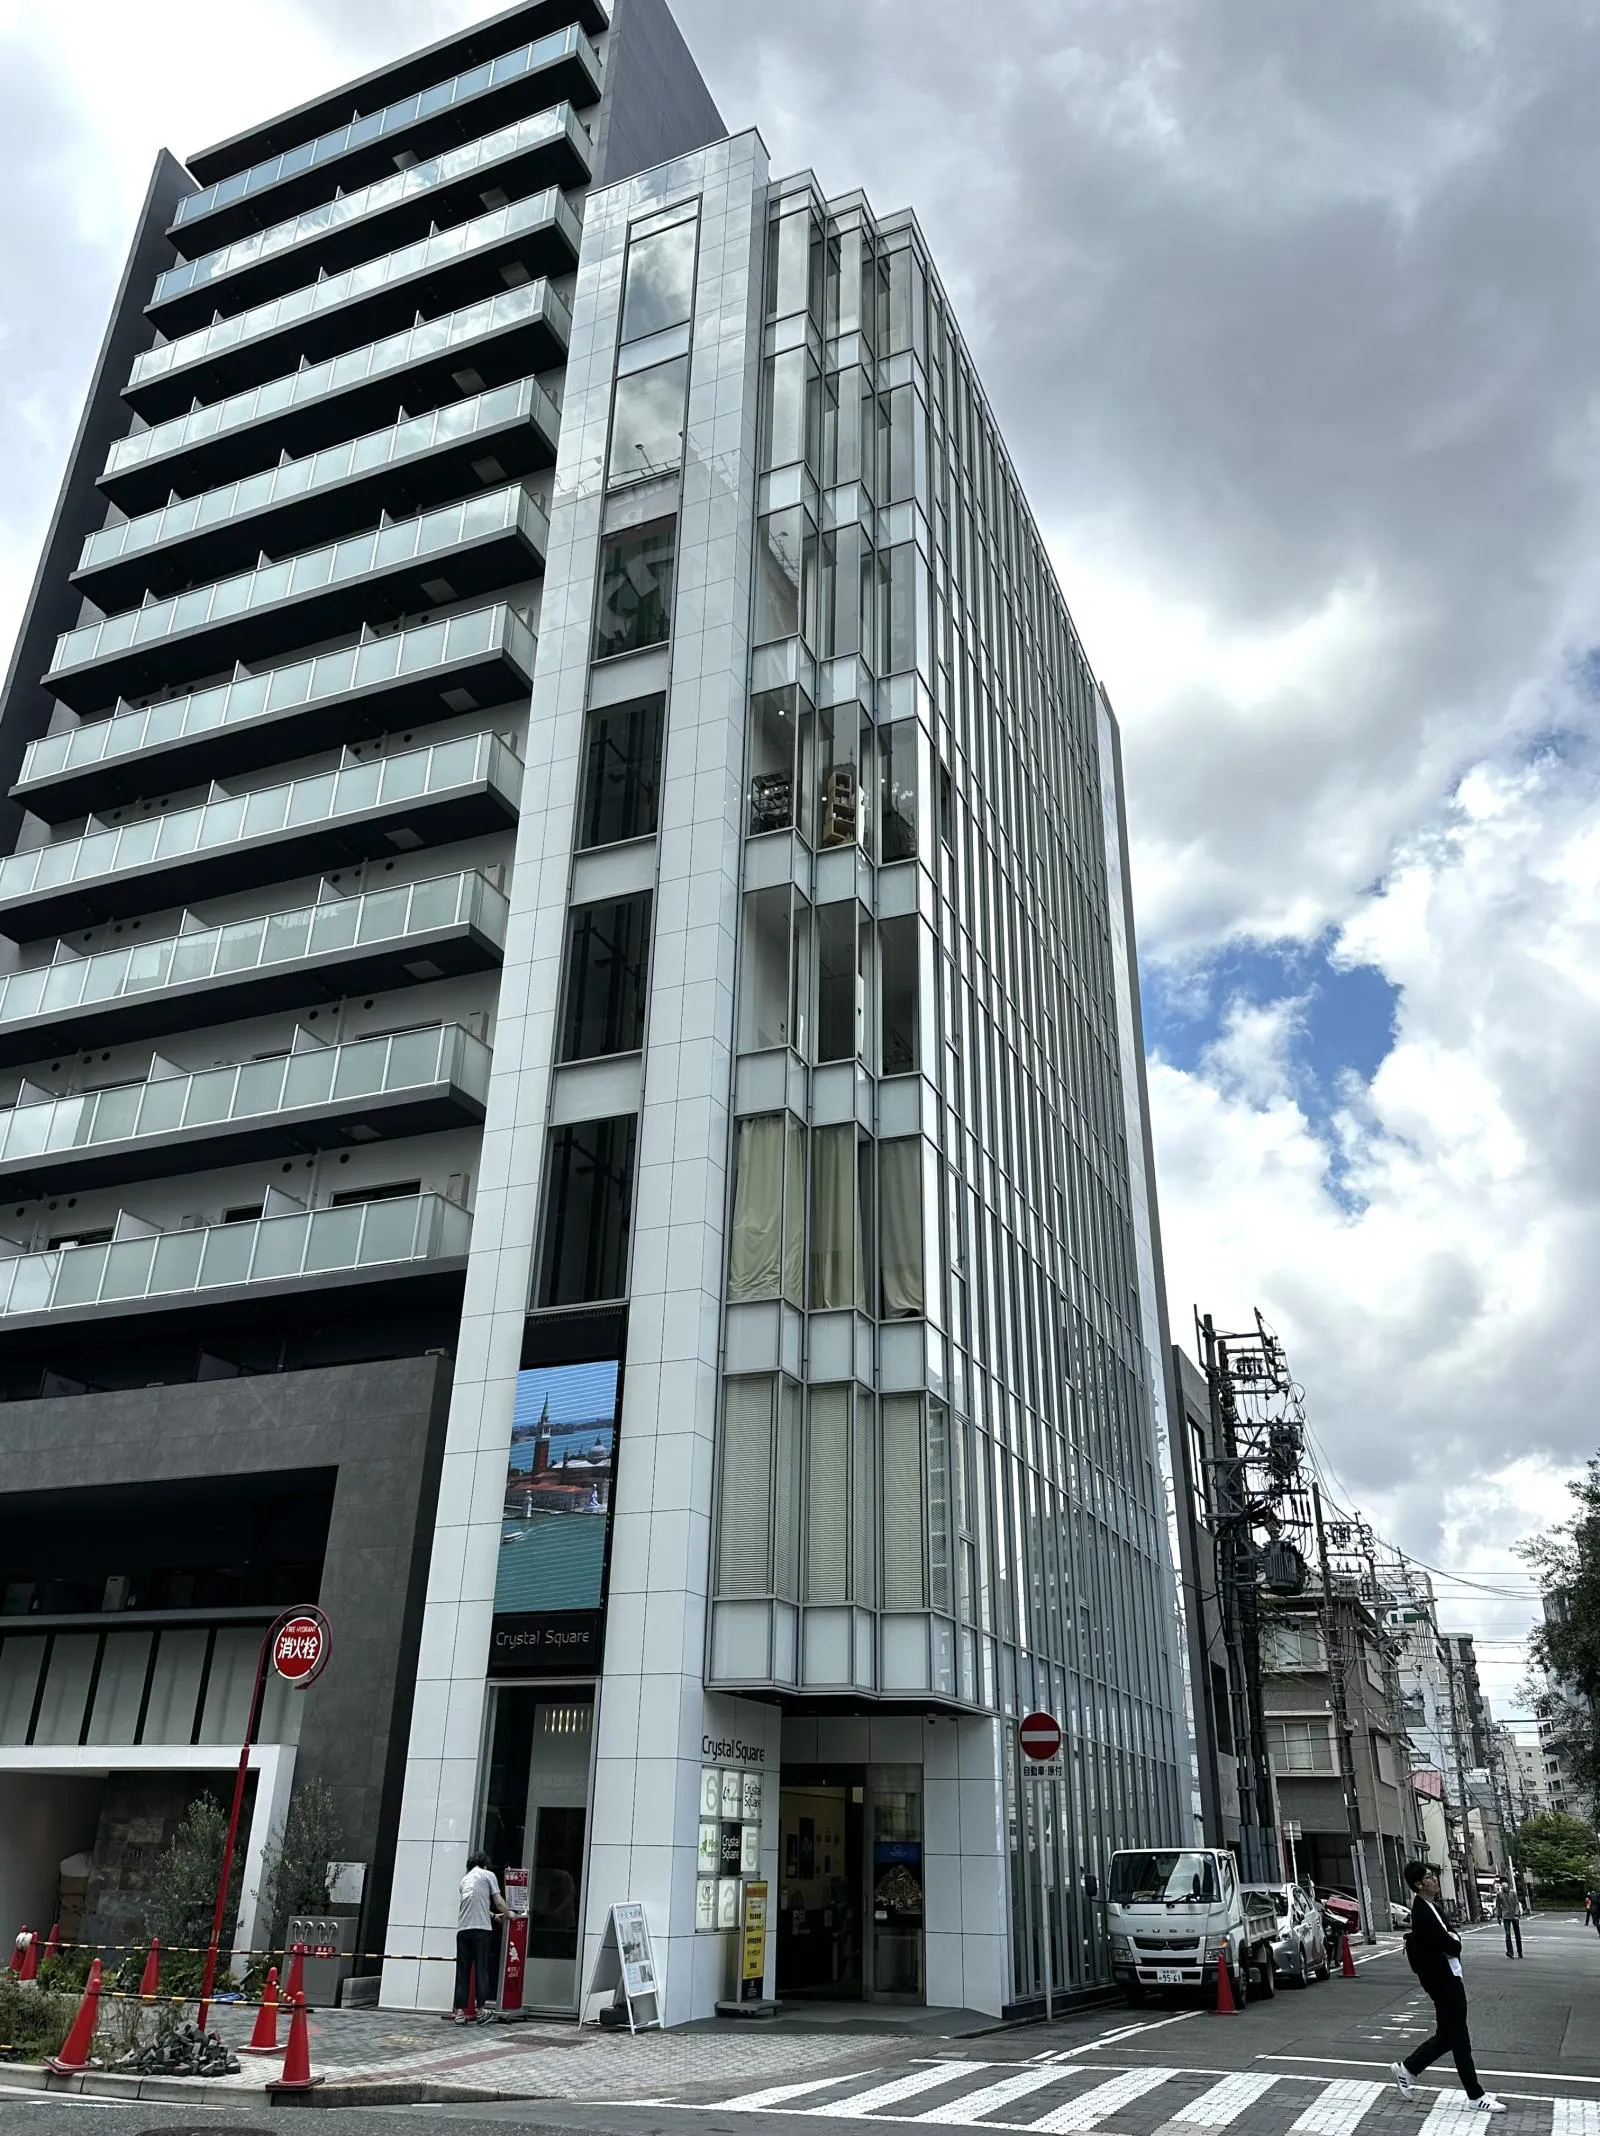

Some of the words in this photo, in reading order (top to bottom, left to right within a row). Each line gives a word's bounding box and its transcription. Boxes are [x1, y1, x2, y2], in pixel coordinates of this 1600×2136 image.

[278, 1636, 318, 1659] 消火栓
[496, 1630, 540, 1649] Crystal
[544, 1629, 590, 1648] Square
[702, 1735, 734, 1761] Crystal
[735, 1740, 765, 1764] Square
[706, 1775, 718, 1811] 6
[722, 1834, 740, 1850] Crystal
[722, 1847, 740, 1862] Square
